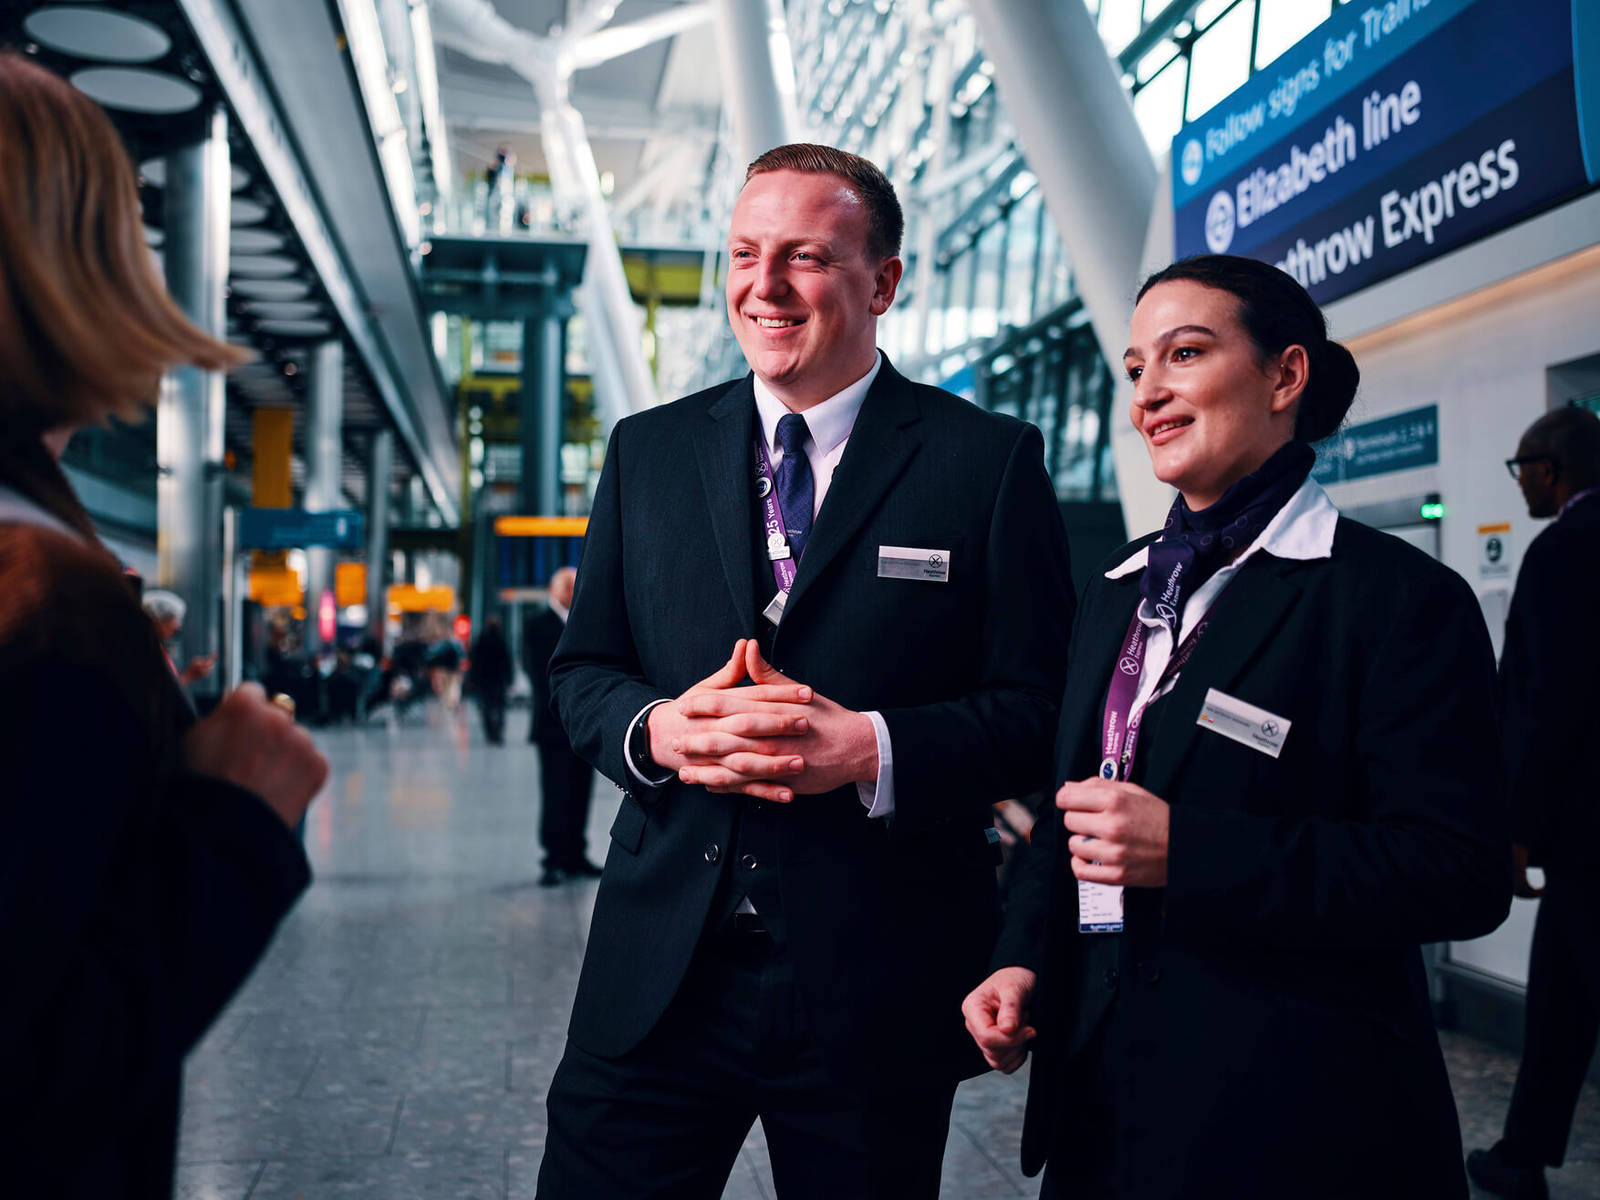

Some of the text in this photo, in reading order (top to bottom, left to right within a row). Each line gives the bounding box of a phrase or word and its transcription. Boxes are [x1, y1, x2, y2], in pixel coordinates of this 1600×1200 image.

[1206, 0, 1432, 163] Follow signs for Train
[1236, 80, 1422, 228] Elizabeth line
[1276, 139, 1519, 289] throw Express
[766, 498, 779, 538] 25 Years
[1160, 561, 1183, 603] Heathrow
[1105, 711, 1118, 755] Heathrow
